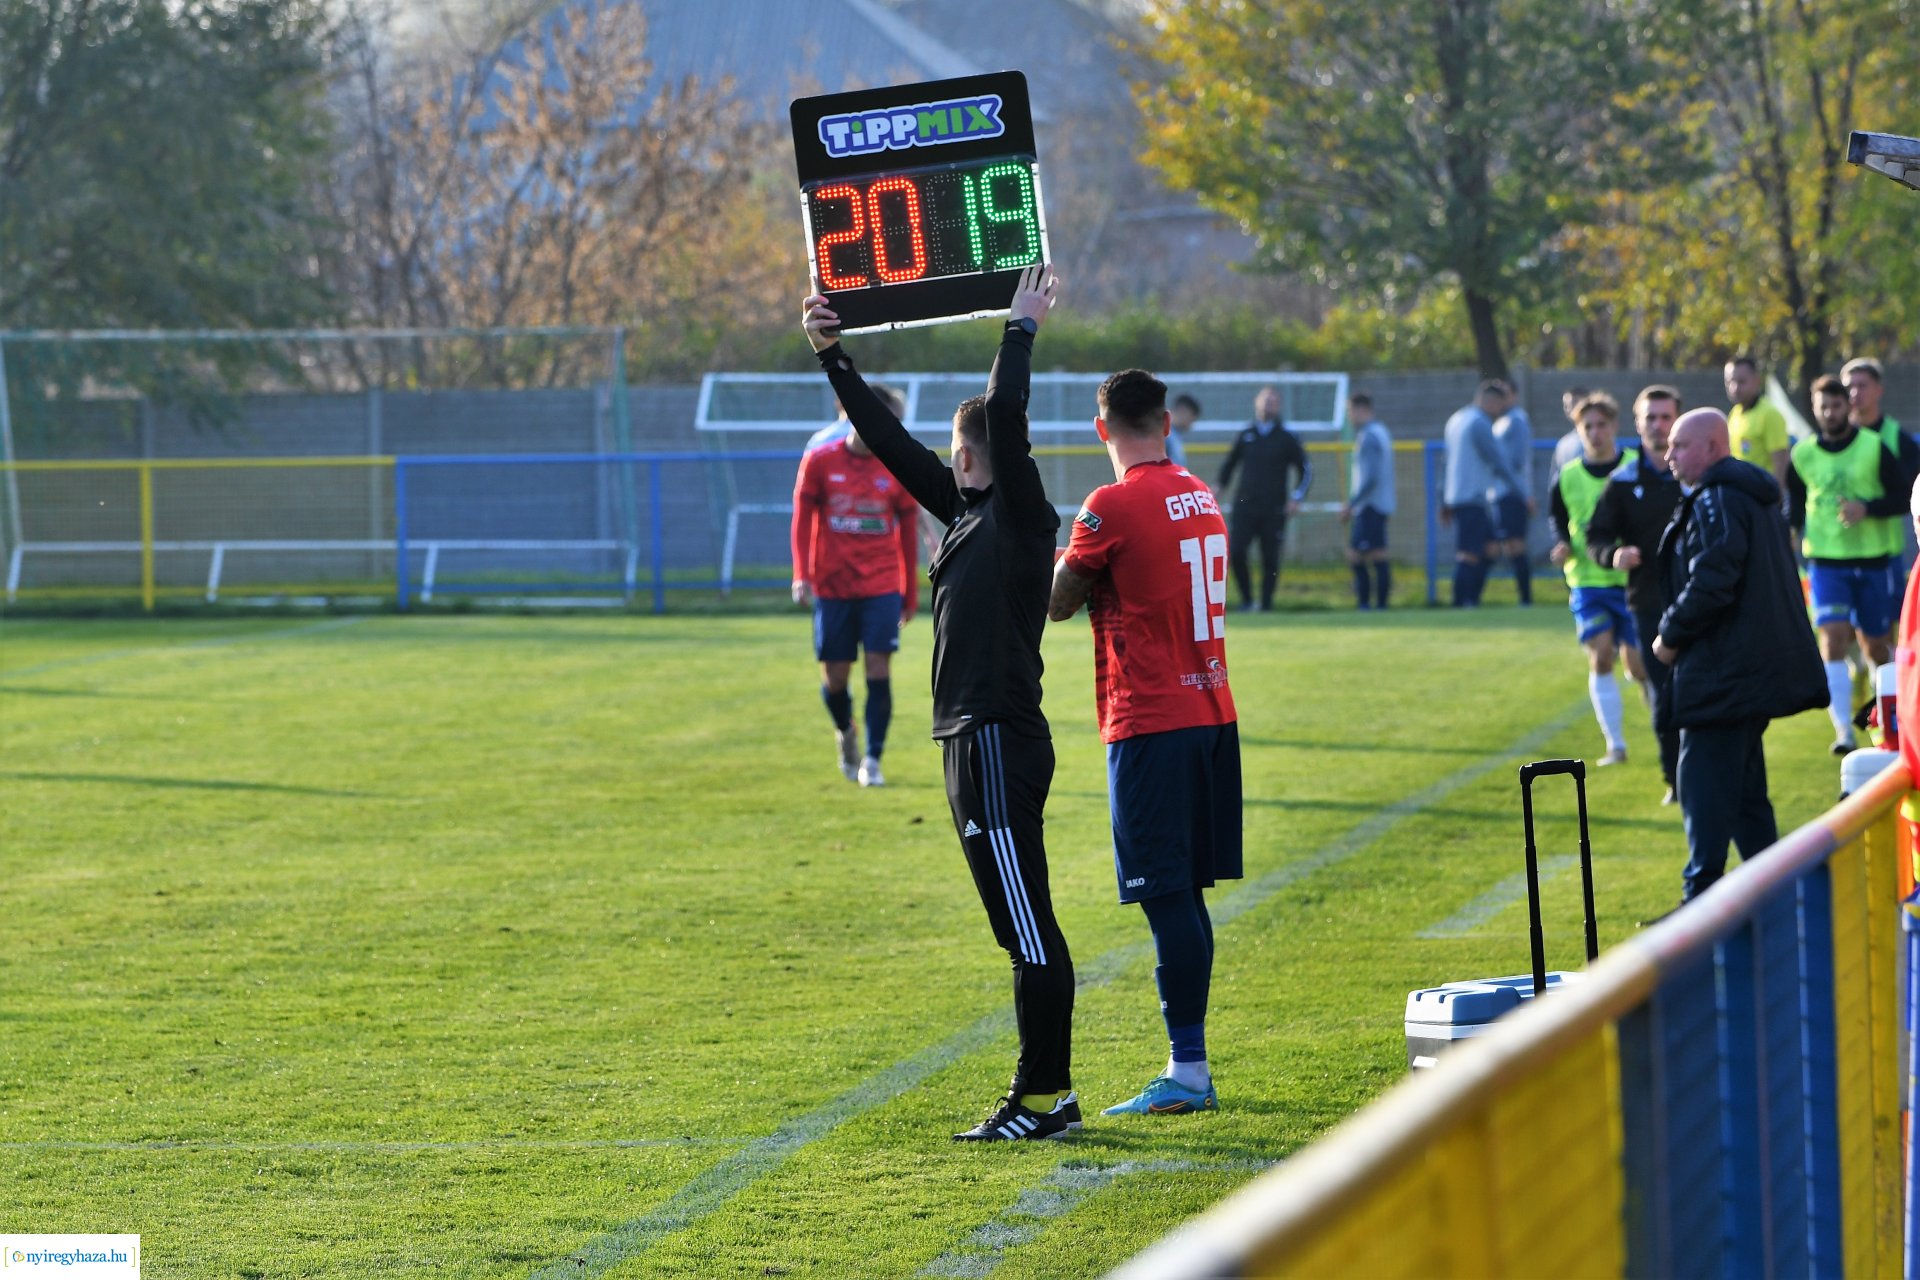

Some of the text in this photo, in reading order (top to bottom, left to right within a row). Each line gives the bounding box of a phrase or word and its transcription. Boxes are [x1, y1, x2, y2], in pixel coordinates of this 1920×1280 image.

[815, 164, 1039, 289] 20 19
[1179, 533, 1228, 642] 19
